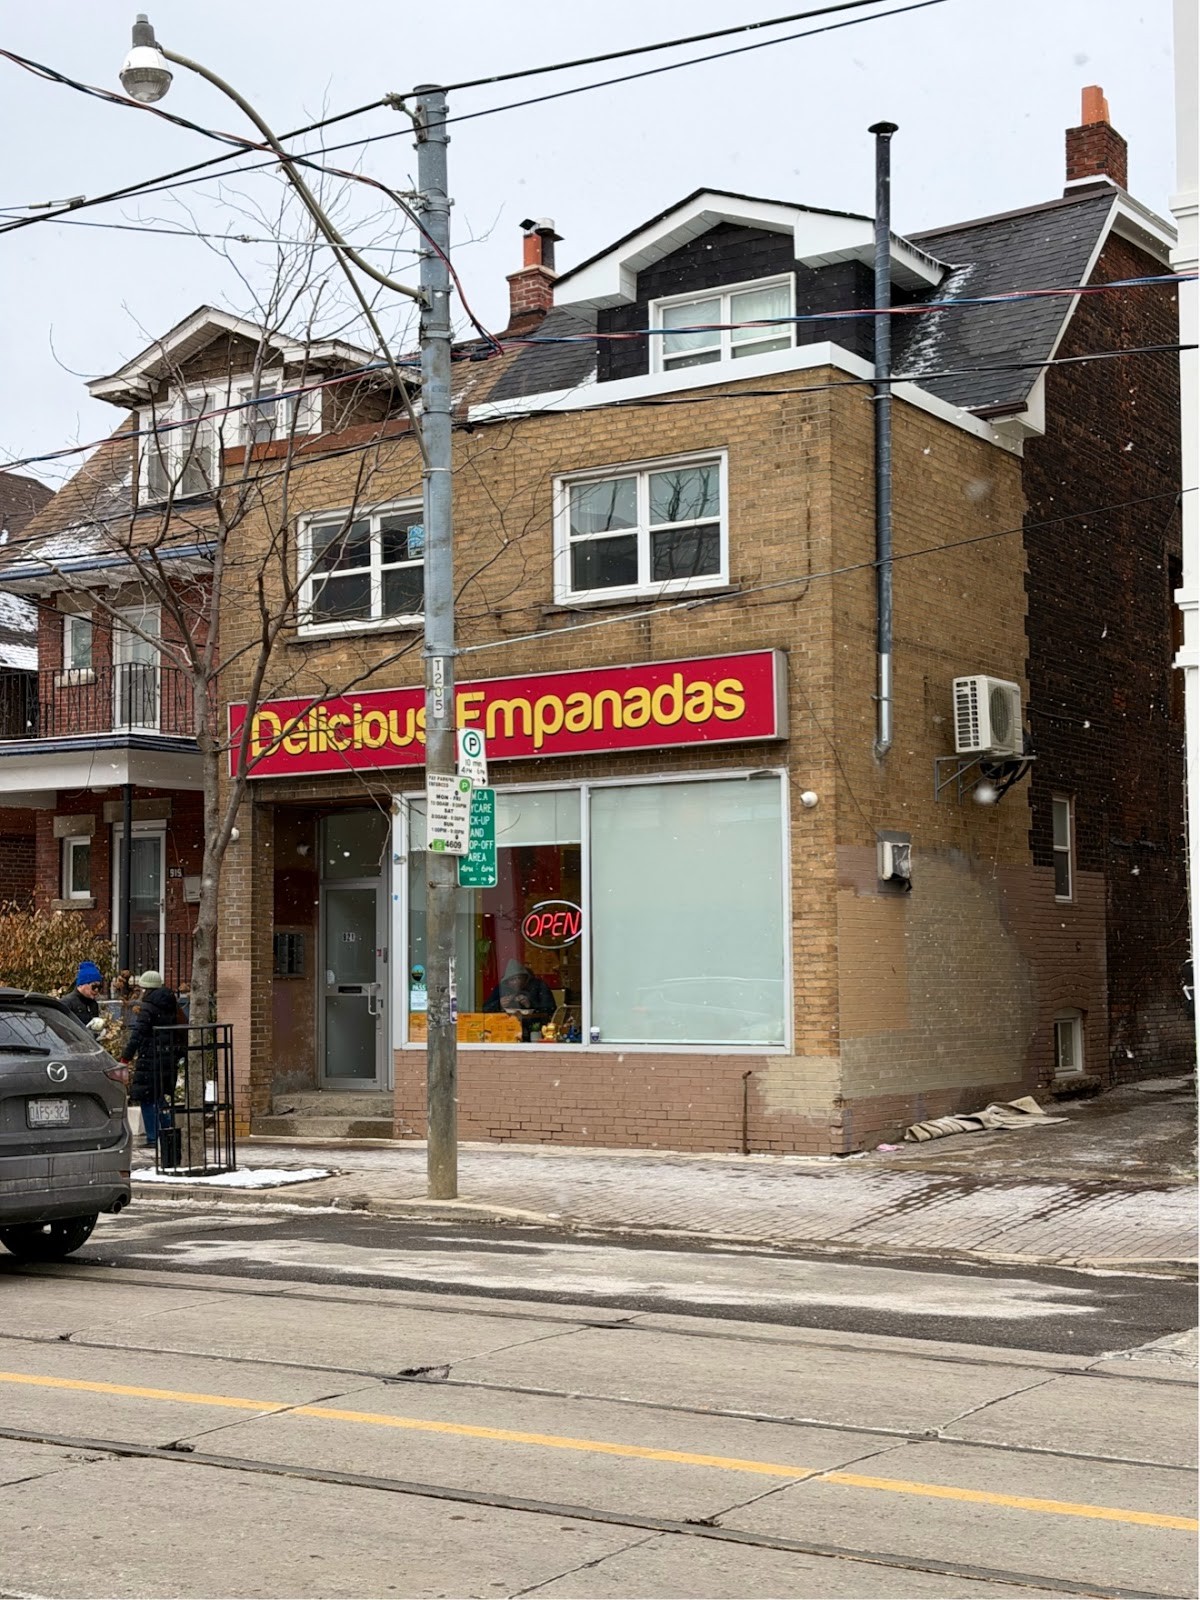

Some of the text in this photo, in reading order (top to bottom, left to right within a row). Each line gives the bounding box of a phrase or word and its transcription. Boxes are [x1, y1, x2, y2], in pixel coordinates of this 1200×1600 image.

[434, 659, 444, 711] T205
[250, 672, 746, 758] Delicious Empanadas
[469, 737, 477, 751] P
[470, 829, 484, 838] AND
[446, 840, 462, 849] 4609
[468, 852, 486, 862] AREA
[525, 911, 581, 937] OPEN
